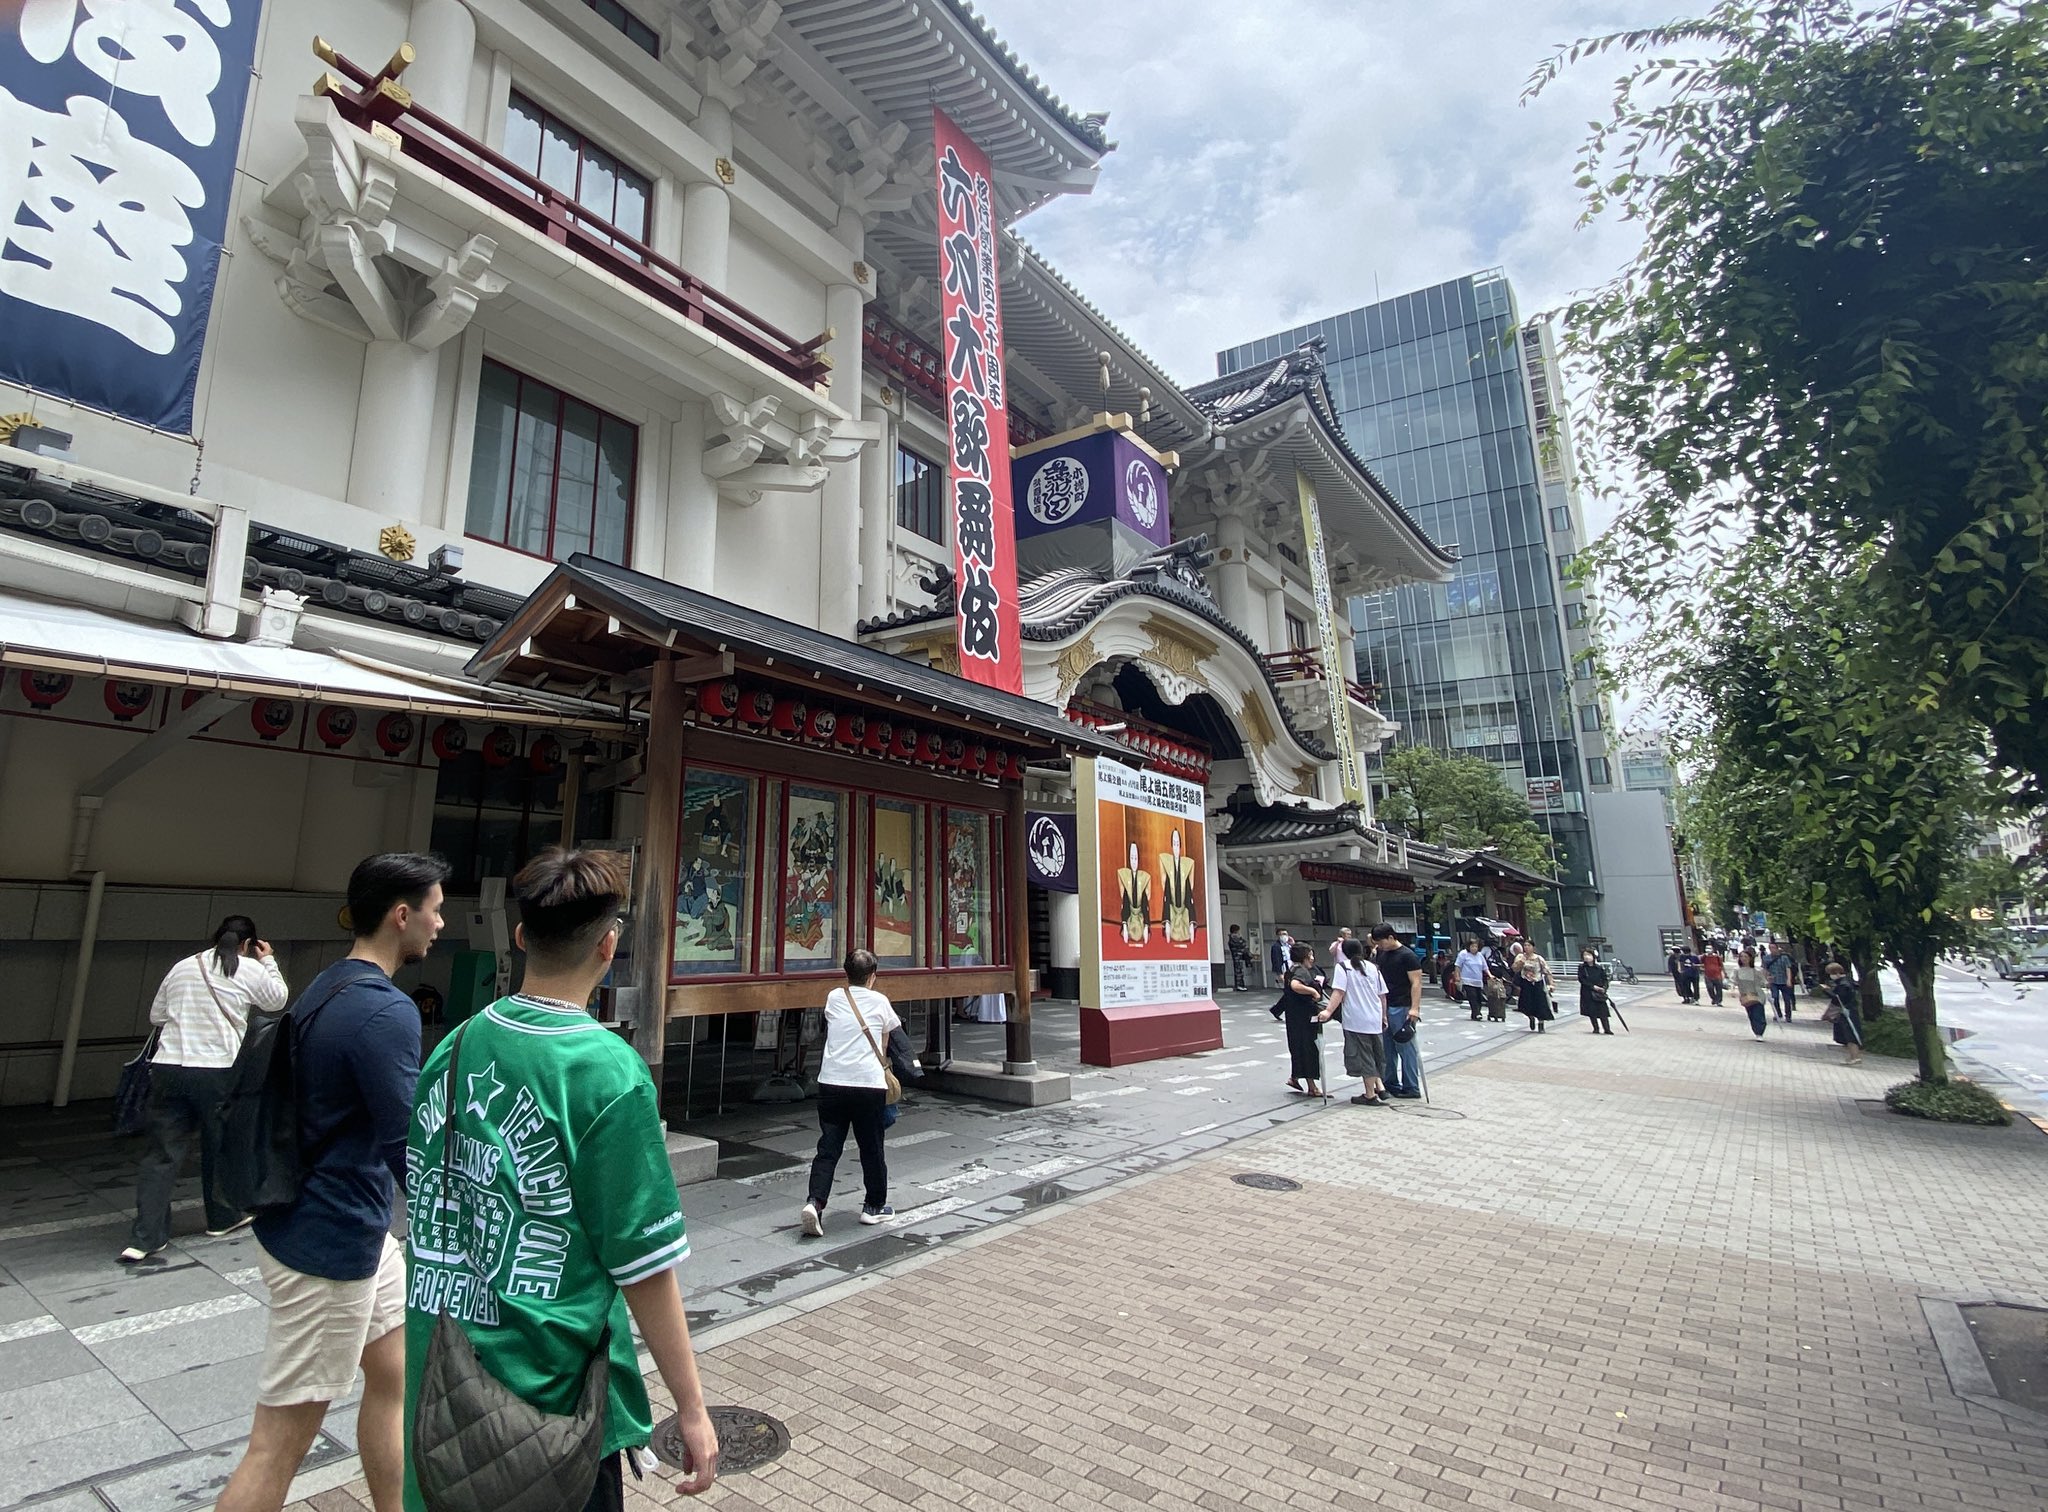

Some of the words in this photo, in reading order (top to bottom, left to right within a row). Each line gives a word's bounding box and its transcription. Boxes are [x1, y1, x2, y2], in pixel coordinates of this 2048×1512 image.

[938, 145, 1000, 664] 六月大歌舞伎
[498, 1085, 573, 1216] TEACH
[408, 1266, 501, 1327] FOREVER
[506, 1220, 572, 1300] ONE
